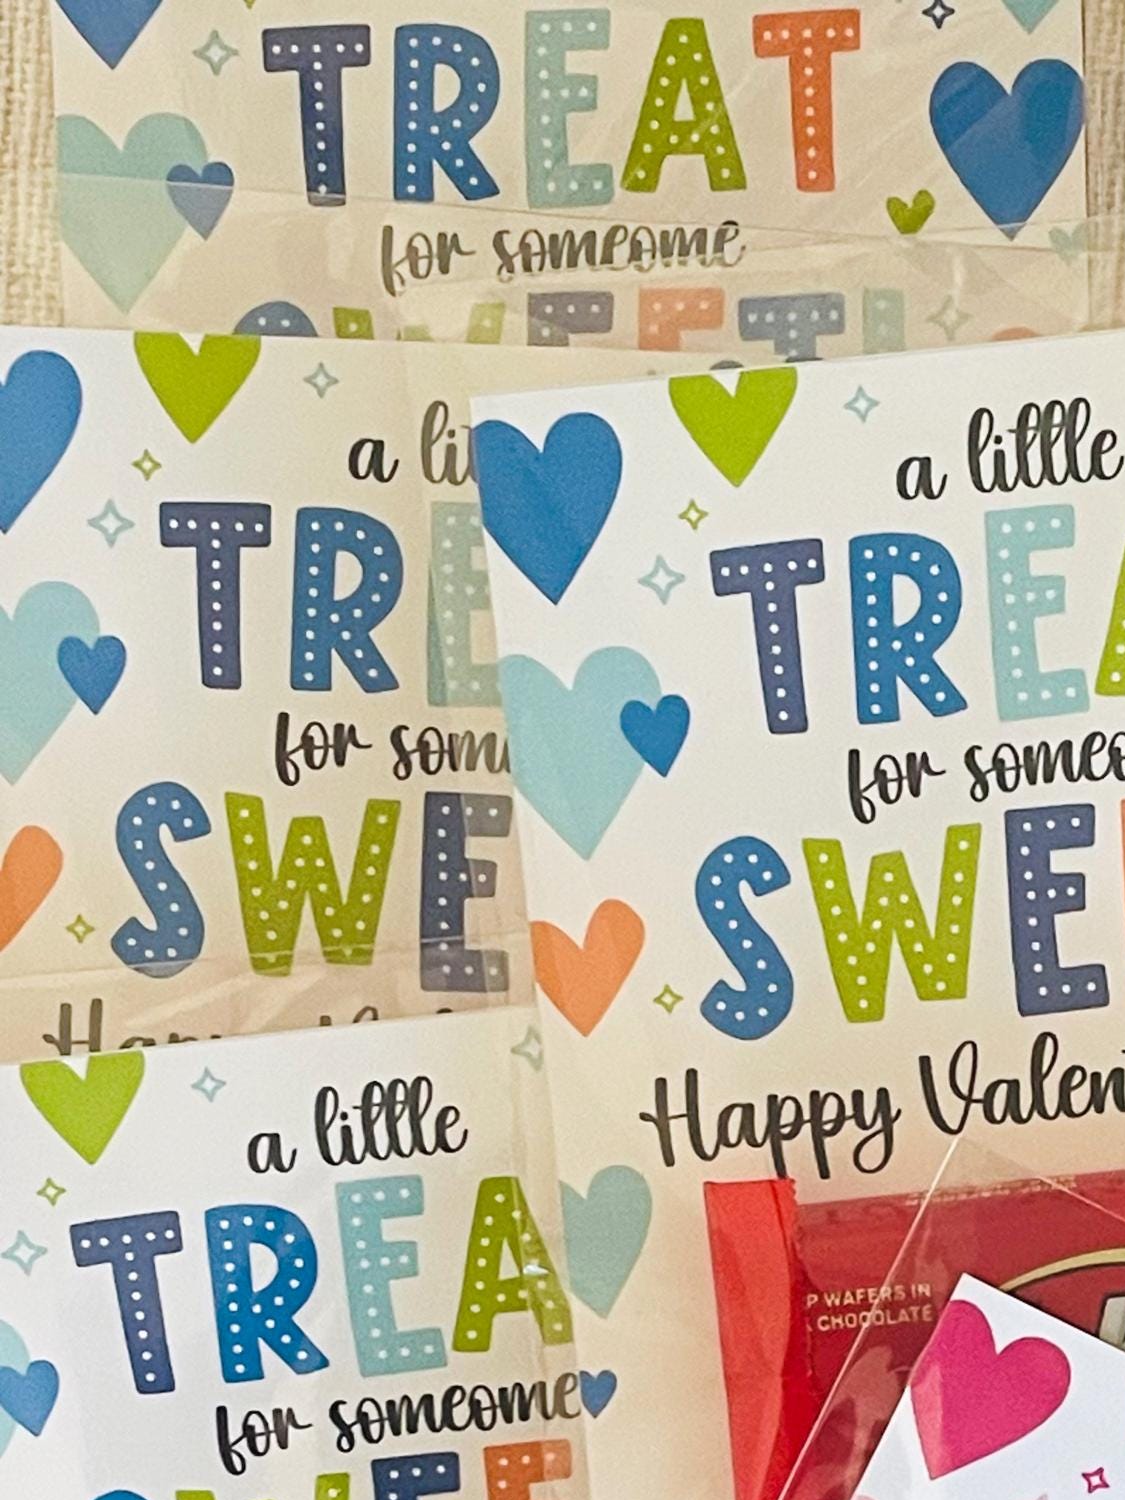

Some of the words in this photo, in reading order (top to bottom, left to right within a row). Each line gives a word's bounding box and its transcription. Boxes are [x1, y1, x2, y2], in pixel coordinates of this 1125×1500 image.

[262, 8, 861, 207] TREAT
[381, 223, 477, 297] for
[348, 437, 400, 484] a
[895, 456, 947, 501] a
[967, 396, 1125, 494] little
[159, 501, 503, 708] TRE
[274, 711, 373, 787] for
[389, 722, 512, 781] som
[847, 747, 947, 825] for
[110, 780, 514, 993] SWE
[247, 1125, 297, 1174] a
[314, 1074, 469, 1168] little
[638, 1066, 901, 1181] Happy
[70, 1174, 574, 1395] TREA
[816, 1303, 935, 1333] CHOCOLATE
[823, 1283, 906, 1307] WAFERS
[911, 1283, 933, 1299] IN
[216, 1404, 314, 1476] for
